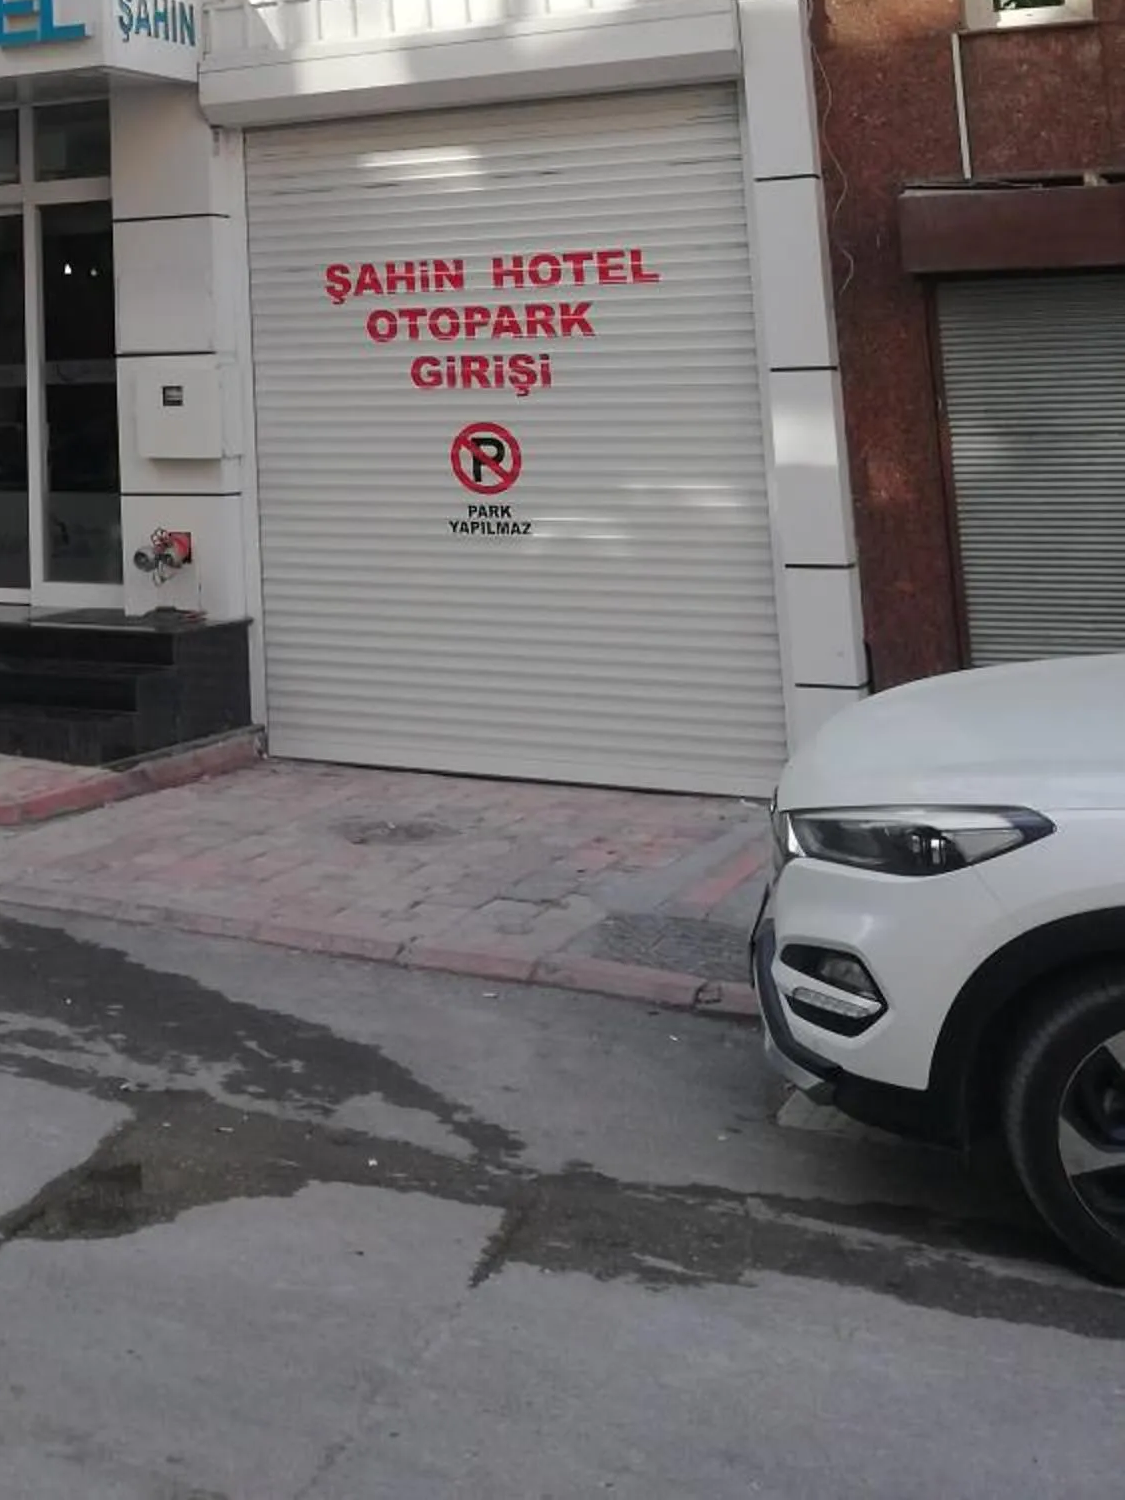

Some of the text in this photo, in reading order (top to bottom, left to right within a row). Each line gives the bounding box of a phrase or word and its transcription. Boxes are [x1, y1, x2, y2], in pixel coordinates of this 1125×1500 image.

[492, 249, 660, 289] HOTEL
[367, 302, 596, 342] OTOPARK
[471, 437, 506, 483] P
[449, 520, 532, 535] YAPILMAZ
[468, 505, 512, 518] PARK
